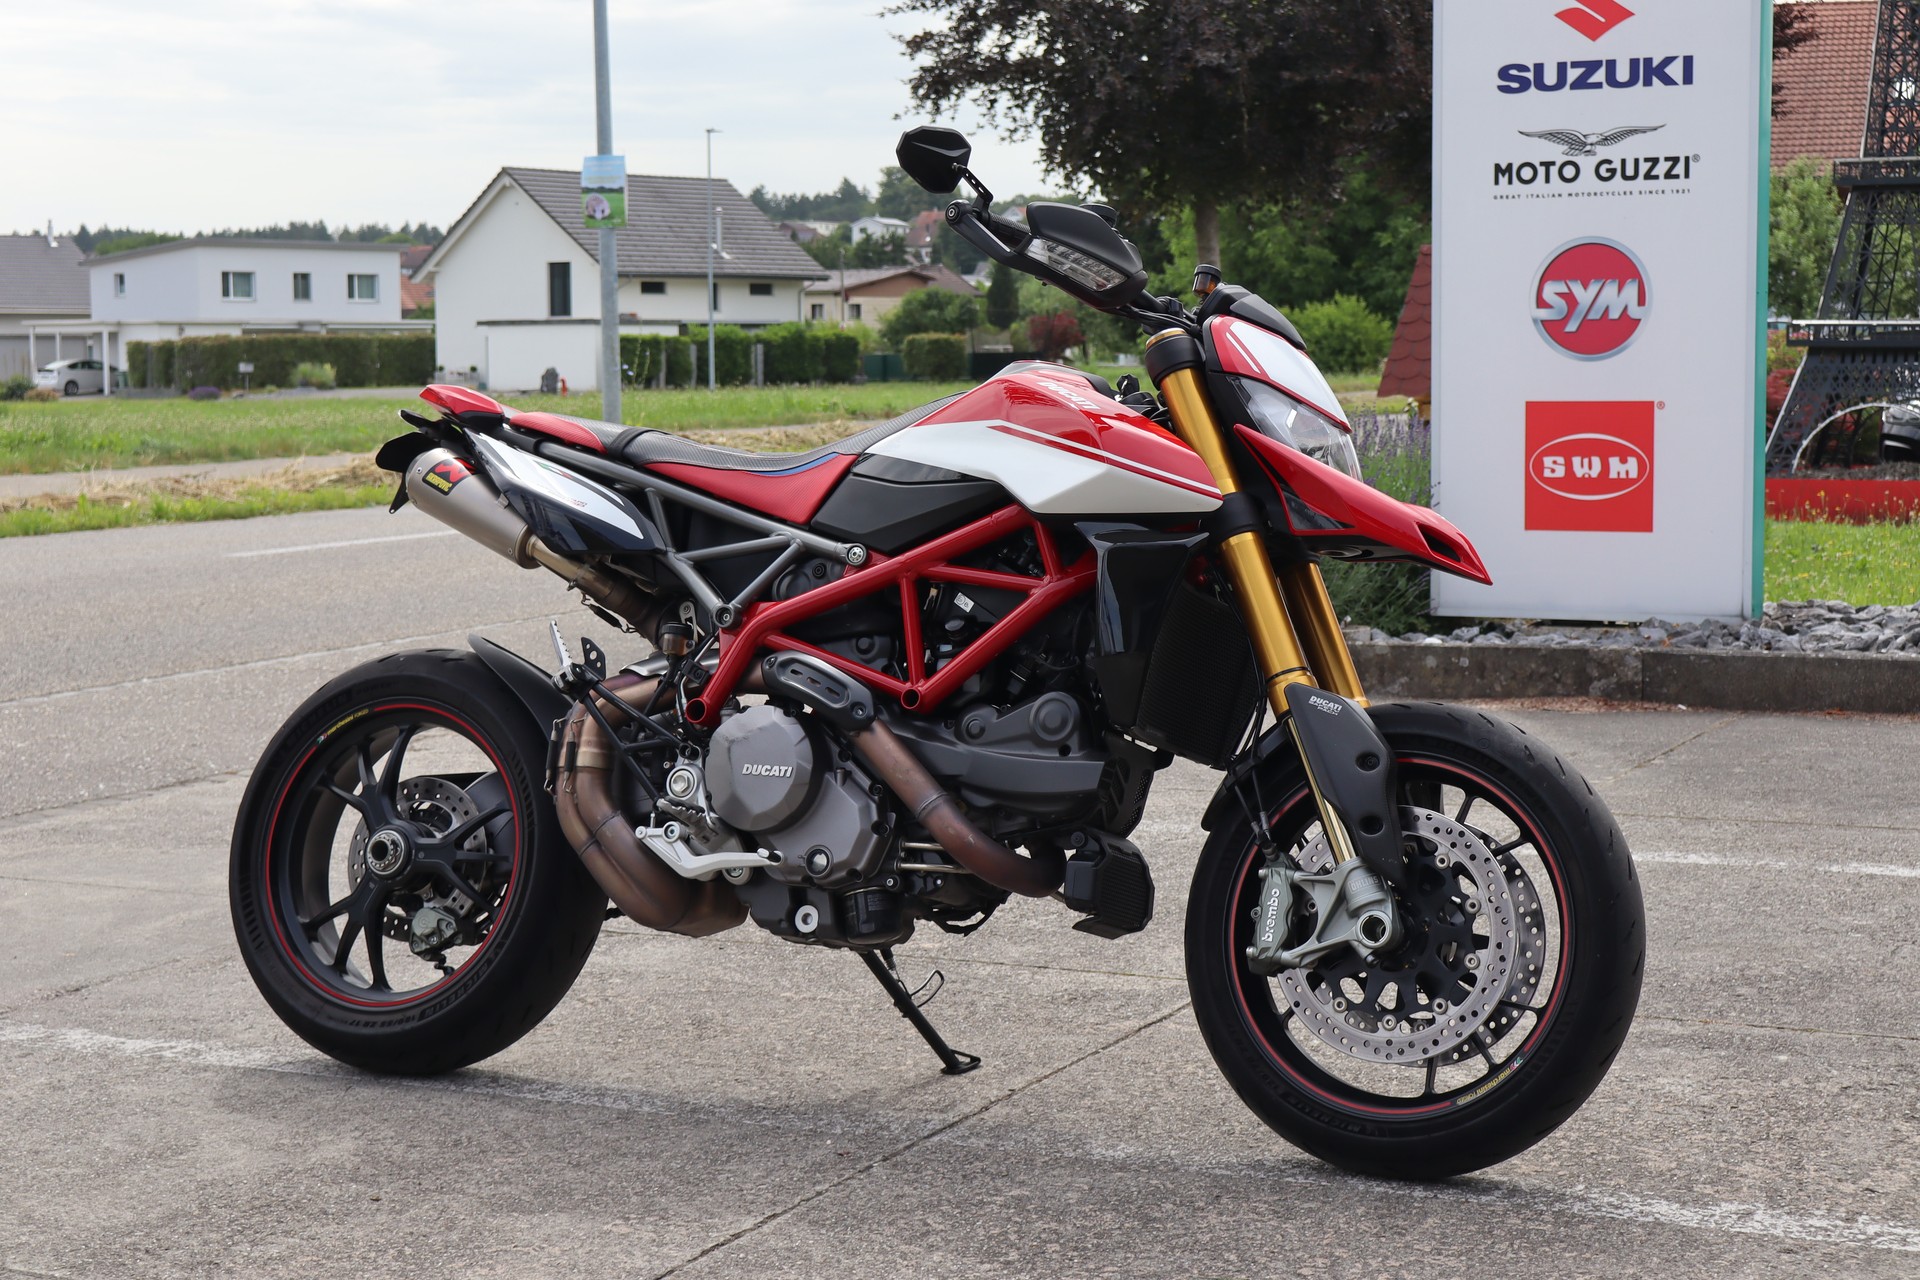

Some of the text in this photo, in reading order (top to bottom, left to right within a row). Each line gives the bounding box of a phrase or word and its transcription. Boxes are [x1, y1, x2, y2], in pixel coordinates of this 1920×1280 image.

[1496, 55, 1694, 94] SUZUKI
[1494, 160, 1581, 186] MOTO
[1567, 190, 1634, 198] MOTORCYCLES
[1532, 279, 1646, 332] SYM
[1036, 382, 1101, 409] DUCATI
[1542, 456, 1639, 479] SWM
[1309, 695, 1343, 711] DUCATI
[742, 763, 793, 778] DUCATI
[1262, 888, 1280, 942] brembo
[425, 962, 488, 1017] MICHELIN
[1476, 1067, 1510, 1096] marchesini
